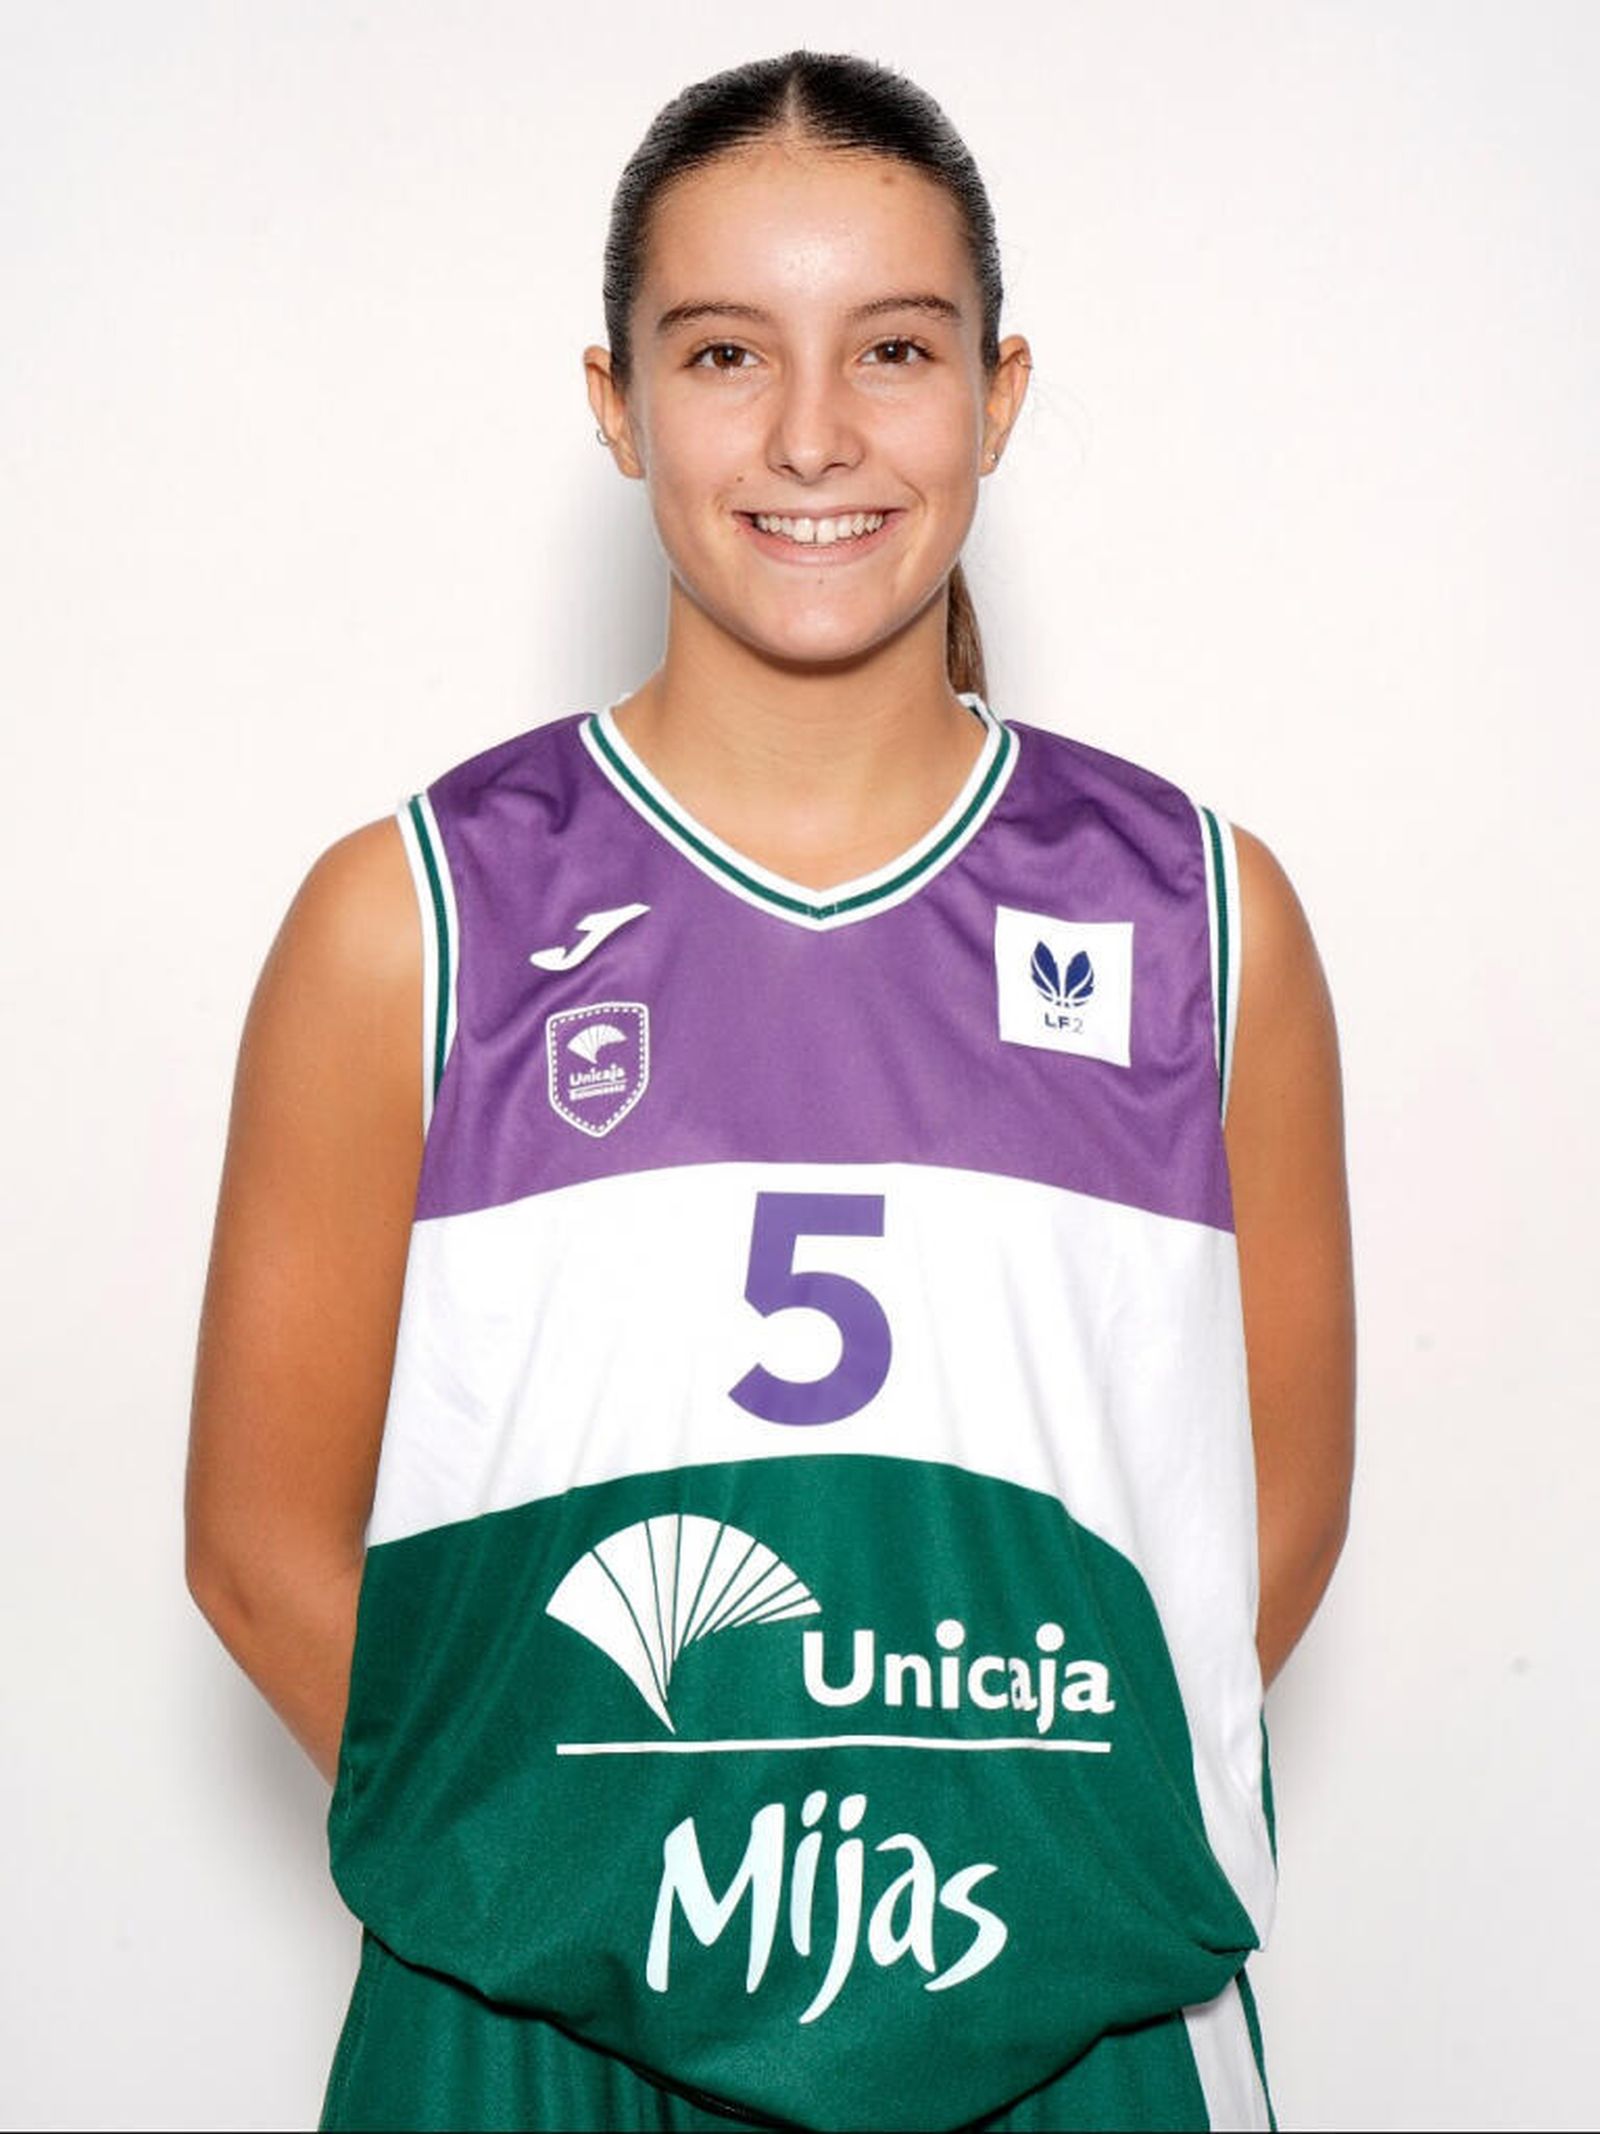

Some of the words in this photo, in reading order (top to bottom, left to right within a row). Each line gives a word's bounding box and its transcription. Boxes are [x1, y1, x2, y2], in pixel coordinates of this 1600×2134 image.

[570, 1063, 625, 1086] Unicaja
[1044, 1012, 1083, 1034] LF2
[728, 1192, 892, 1426] 5
[803, 1619, 1115, 1734] Unicaja
[646, 1790, 1008, 2024] Mijas
